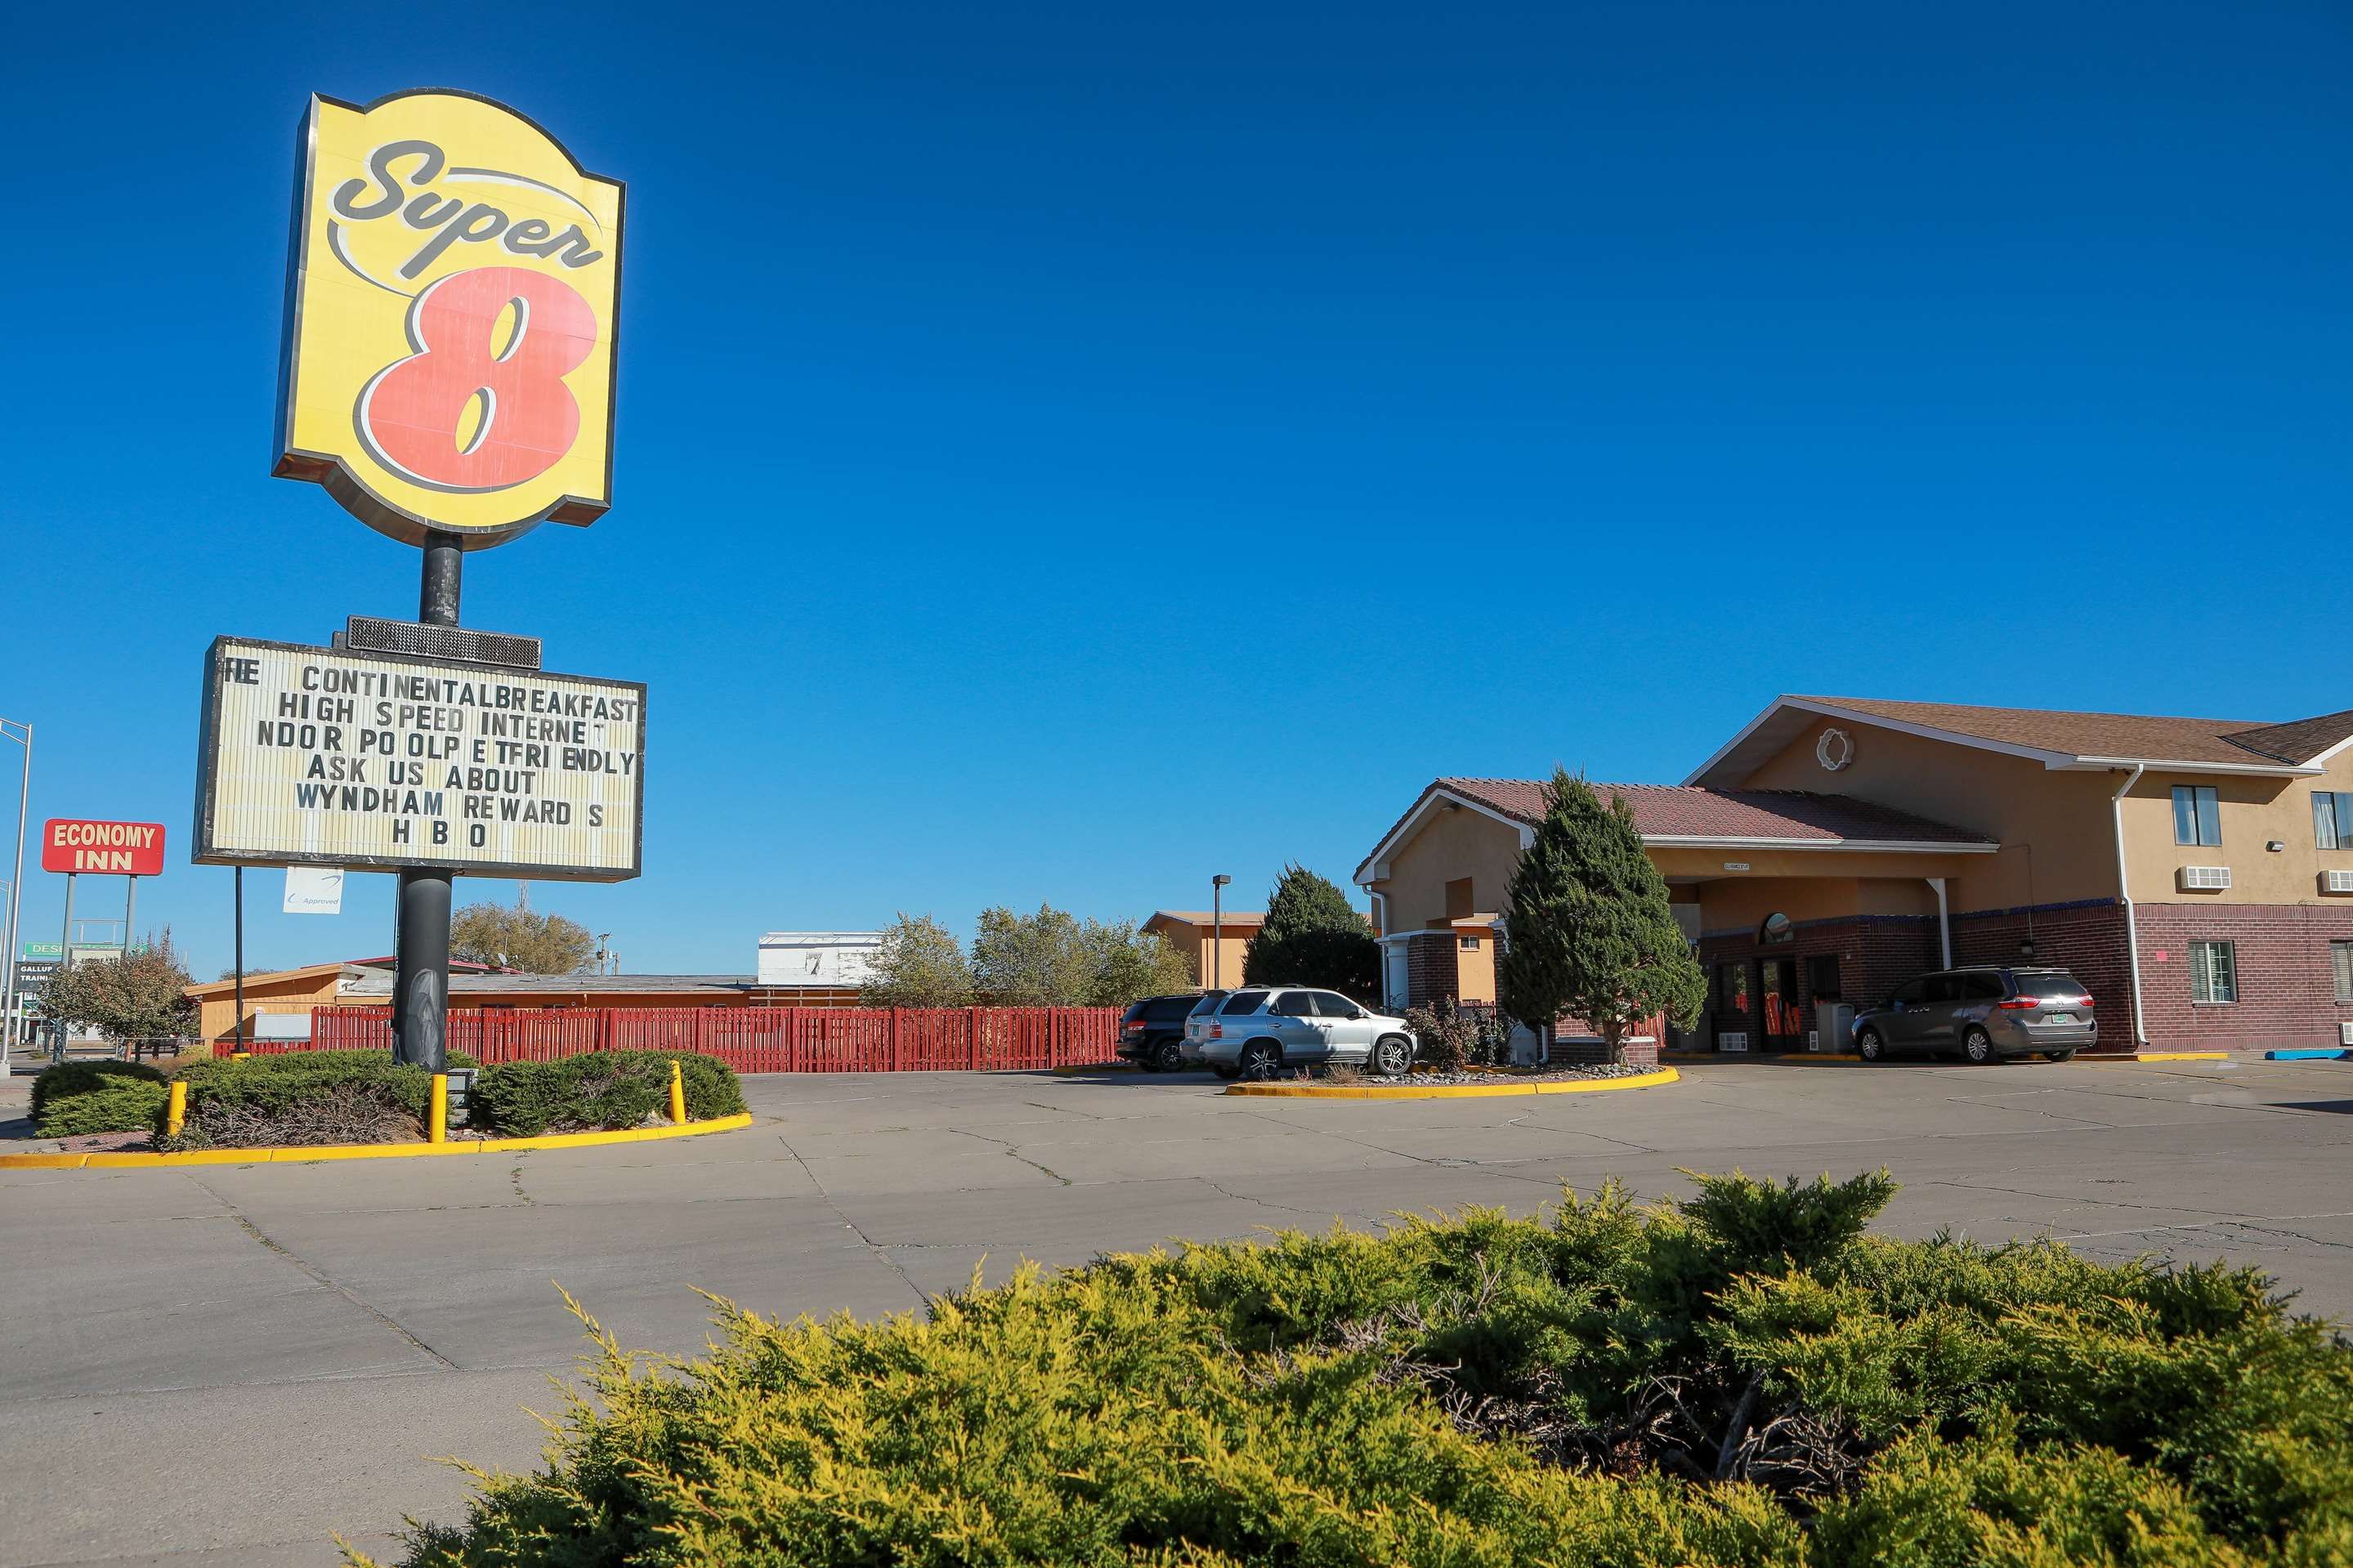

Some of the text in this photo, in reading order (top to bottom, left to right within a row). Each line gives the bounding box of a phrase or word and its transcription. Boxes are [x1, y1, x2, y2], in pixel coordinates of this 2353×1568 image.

[331, 140, 603, 279] Super
[353, 266, 597, 495] 8
[280, 692, 354, 723] HIGH
[377, 701, 463, 733] SPEED
[258, 720, 342, 752] NDOR
[307, 754, 535, 794] ASK US ABOUT
[297, 783, 443, 816] WYNDHAM
[54, 824, 155, 849] ECONOMY
[75, 850, 132, 870] INN
[303, 897, 339, 905] Approved
